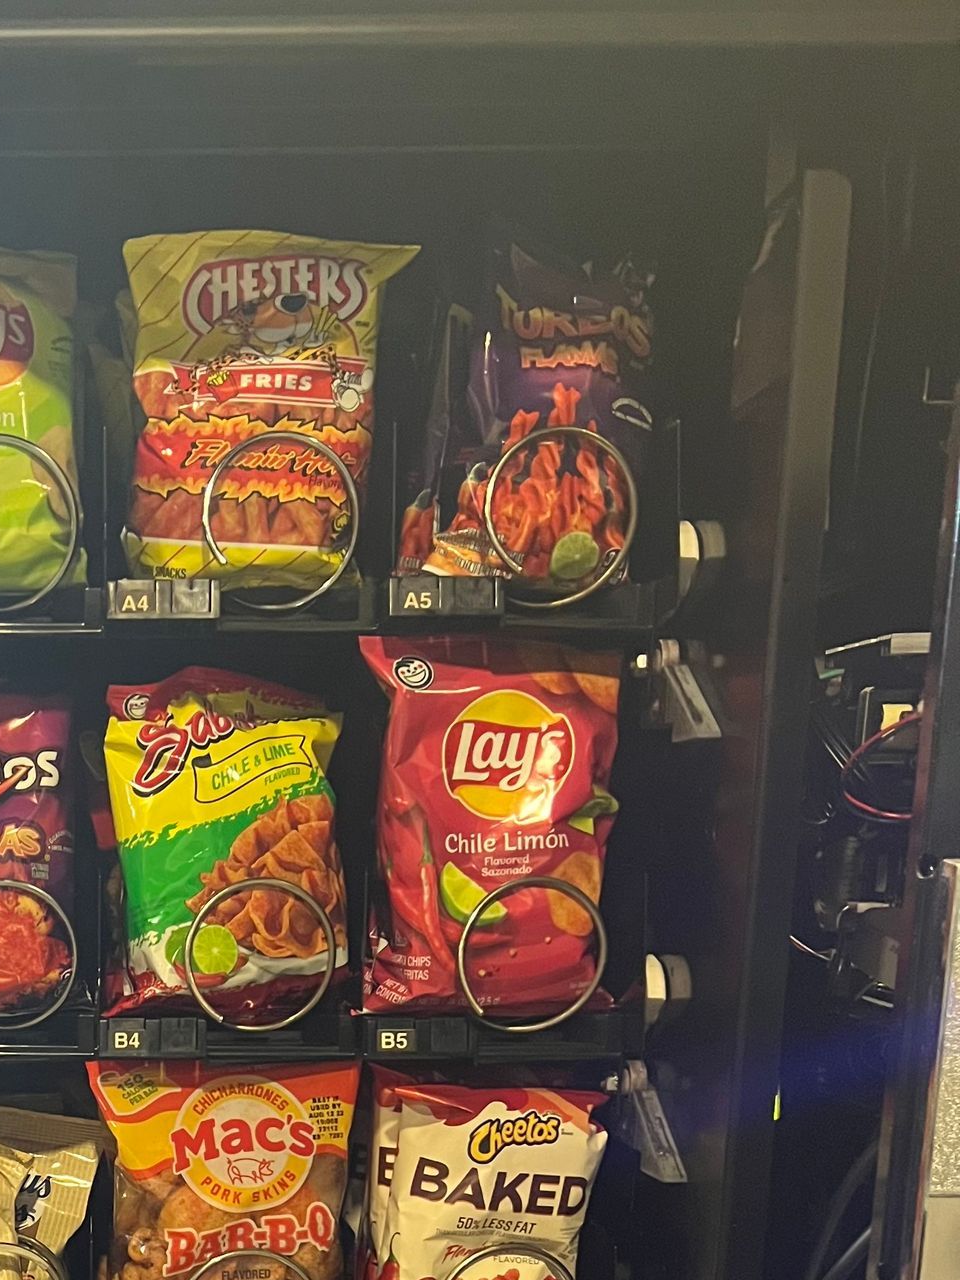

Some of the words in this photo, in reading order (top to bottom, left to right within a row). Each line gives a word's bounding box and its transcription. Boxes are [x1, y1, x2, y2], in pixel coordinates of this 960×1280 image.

[240, 373, 312, 392] FRIES
[122, 596, 149, 613] A4
[404, 592, 432, 610] A5
[452, 722, 565, 792] Lay's
[264, 767, 301, 785] FLAVORED
[446, 832, 497, 854] Chile
[504, 829, 569, 851] Limón
[484, 855, 529, 866] Flavored
[481, 865, 533, 877] Sazonado
[408, 956, 431, 967] CHIPS
[114, 1033, 140, 1048] B4
[381, 1033, 408, 1049] B5
[193, 1083, 289, 1115] CHICHARRONES
[171, 1115, 316, 1173] Mac's
[469, 1112, 560, 1163] Cheetos
[201, 1177, 241, 1204] PORK
[252, 1171, 297, 1202] SKINS
[410, 1157, 589, 1216] BAKED
[456, 1217, 480, 1229] 50%
[482, 1218, 512, 1231] LESS
[513, 1221, 536, 1234] FAT
[164, 1203, 333, 1275] BAR-B-Q
[494, 1256, 539, 1265] FLAVORED
[221, 1269, 271, 1280] FLAVORED
